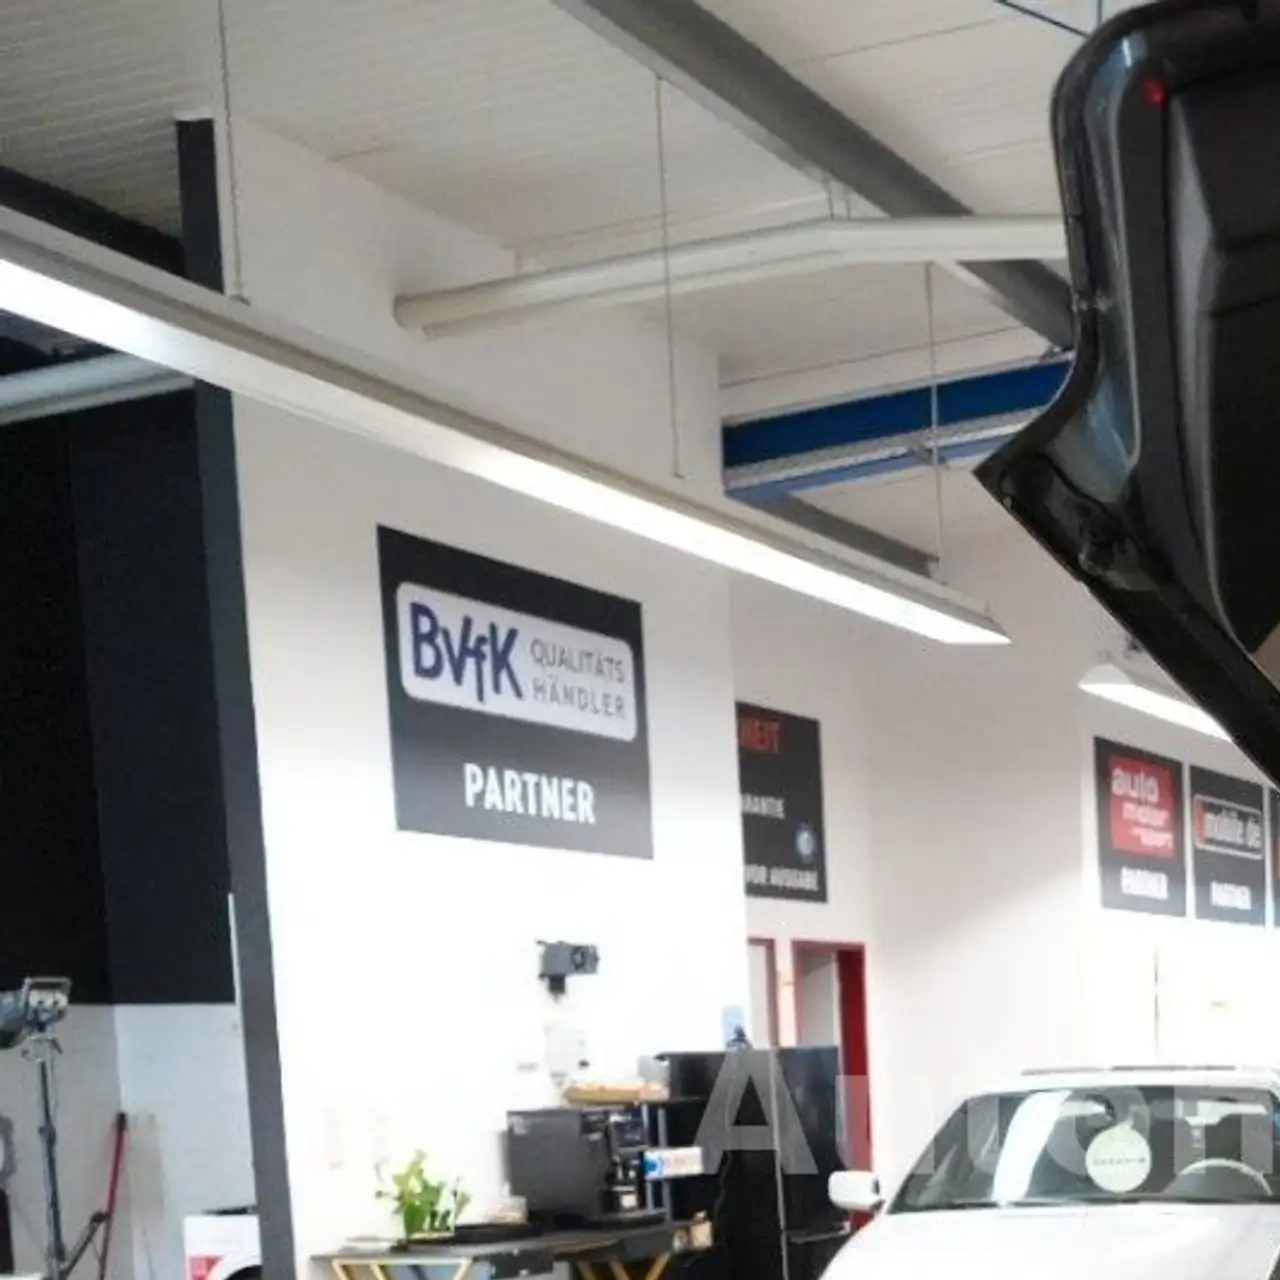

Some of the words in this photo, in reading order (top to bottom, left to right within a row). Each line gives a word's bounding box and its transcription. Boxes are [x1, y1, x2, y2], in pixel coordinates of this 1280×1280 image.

[410, 602, 523, 704] BVfK
[530, 637, 625, 684] QUALITÄTS
[532, 675, 625, 717] HÄNDLER
[464, 762, 596, 824] PARTNER
